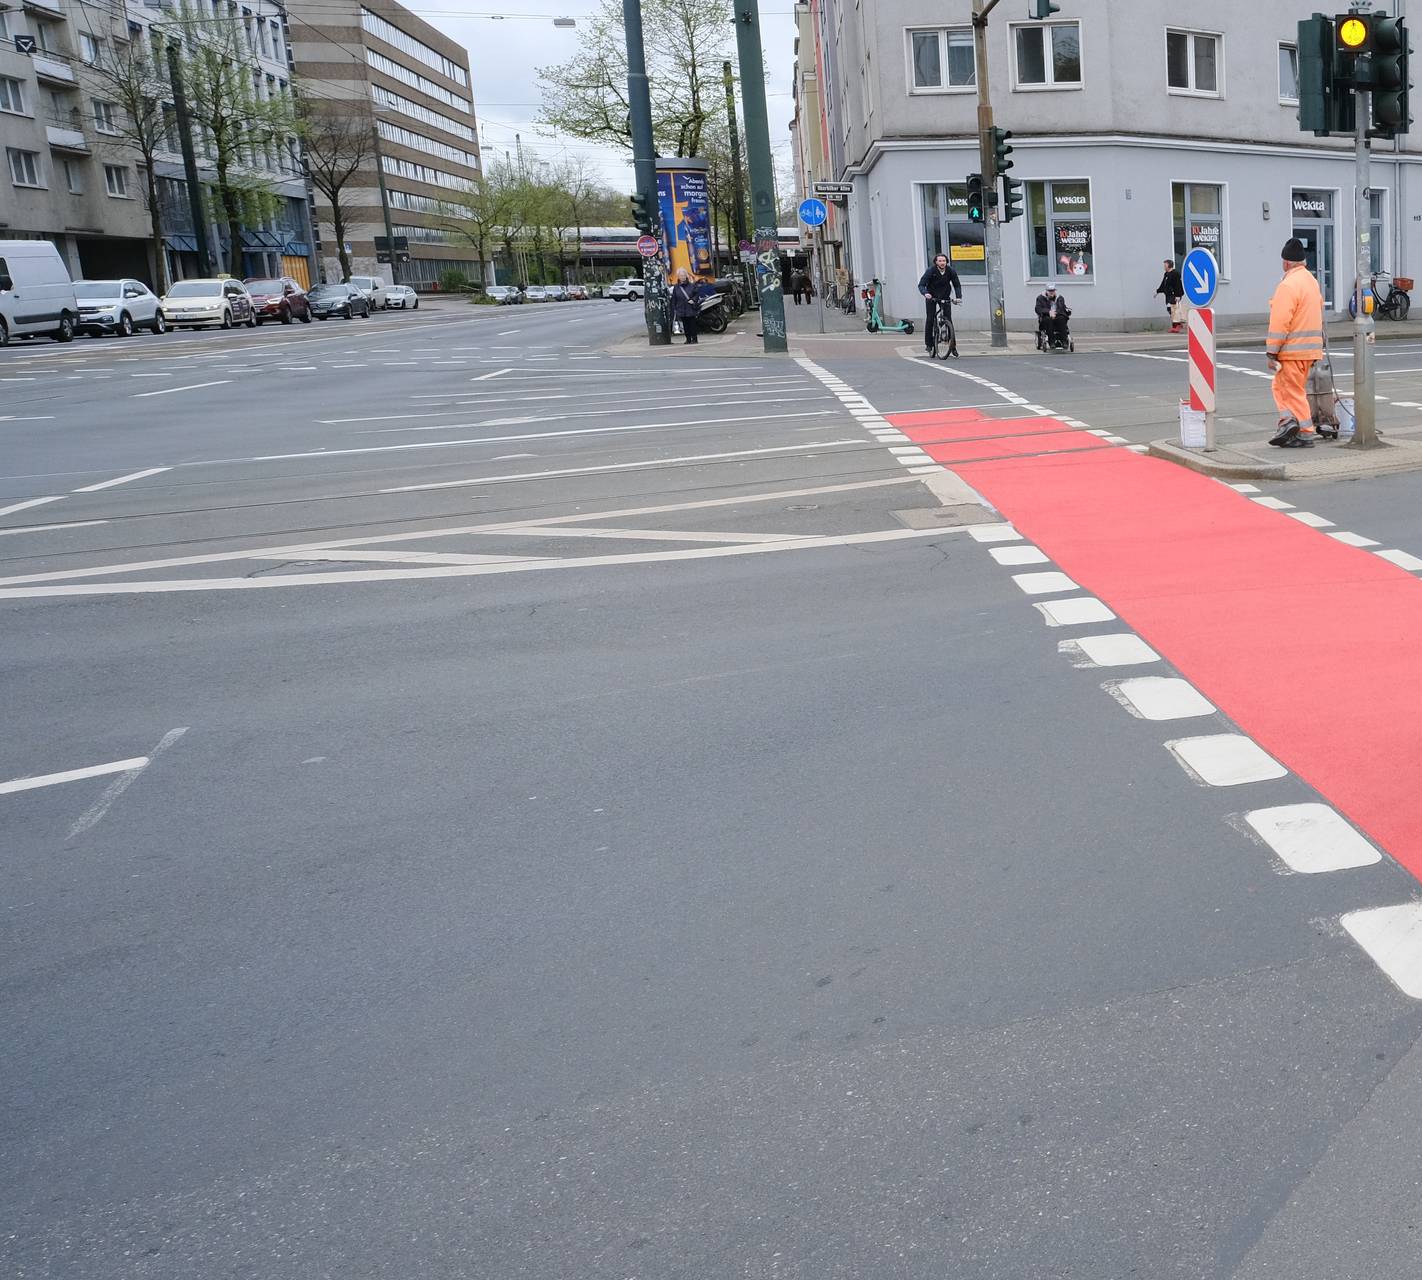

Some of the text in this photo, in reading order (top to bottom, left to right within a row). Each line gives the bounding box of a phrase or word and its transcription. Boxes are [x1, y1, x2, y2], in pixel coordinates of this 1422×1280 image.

[949, 198, 968, 206] wek
[1055, 195, 1086, 204] wekita
[1293, 200, 1325, 211] wekita
[1067, 230, 1088, 238] Jahre
[1199, 226, 1220, 235] Jahre
[1193, 234, 1218, 242] wekita
